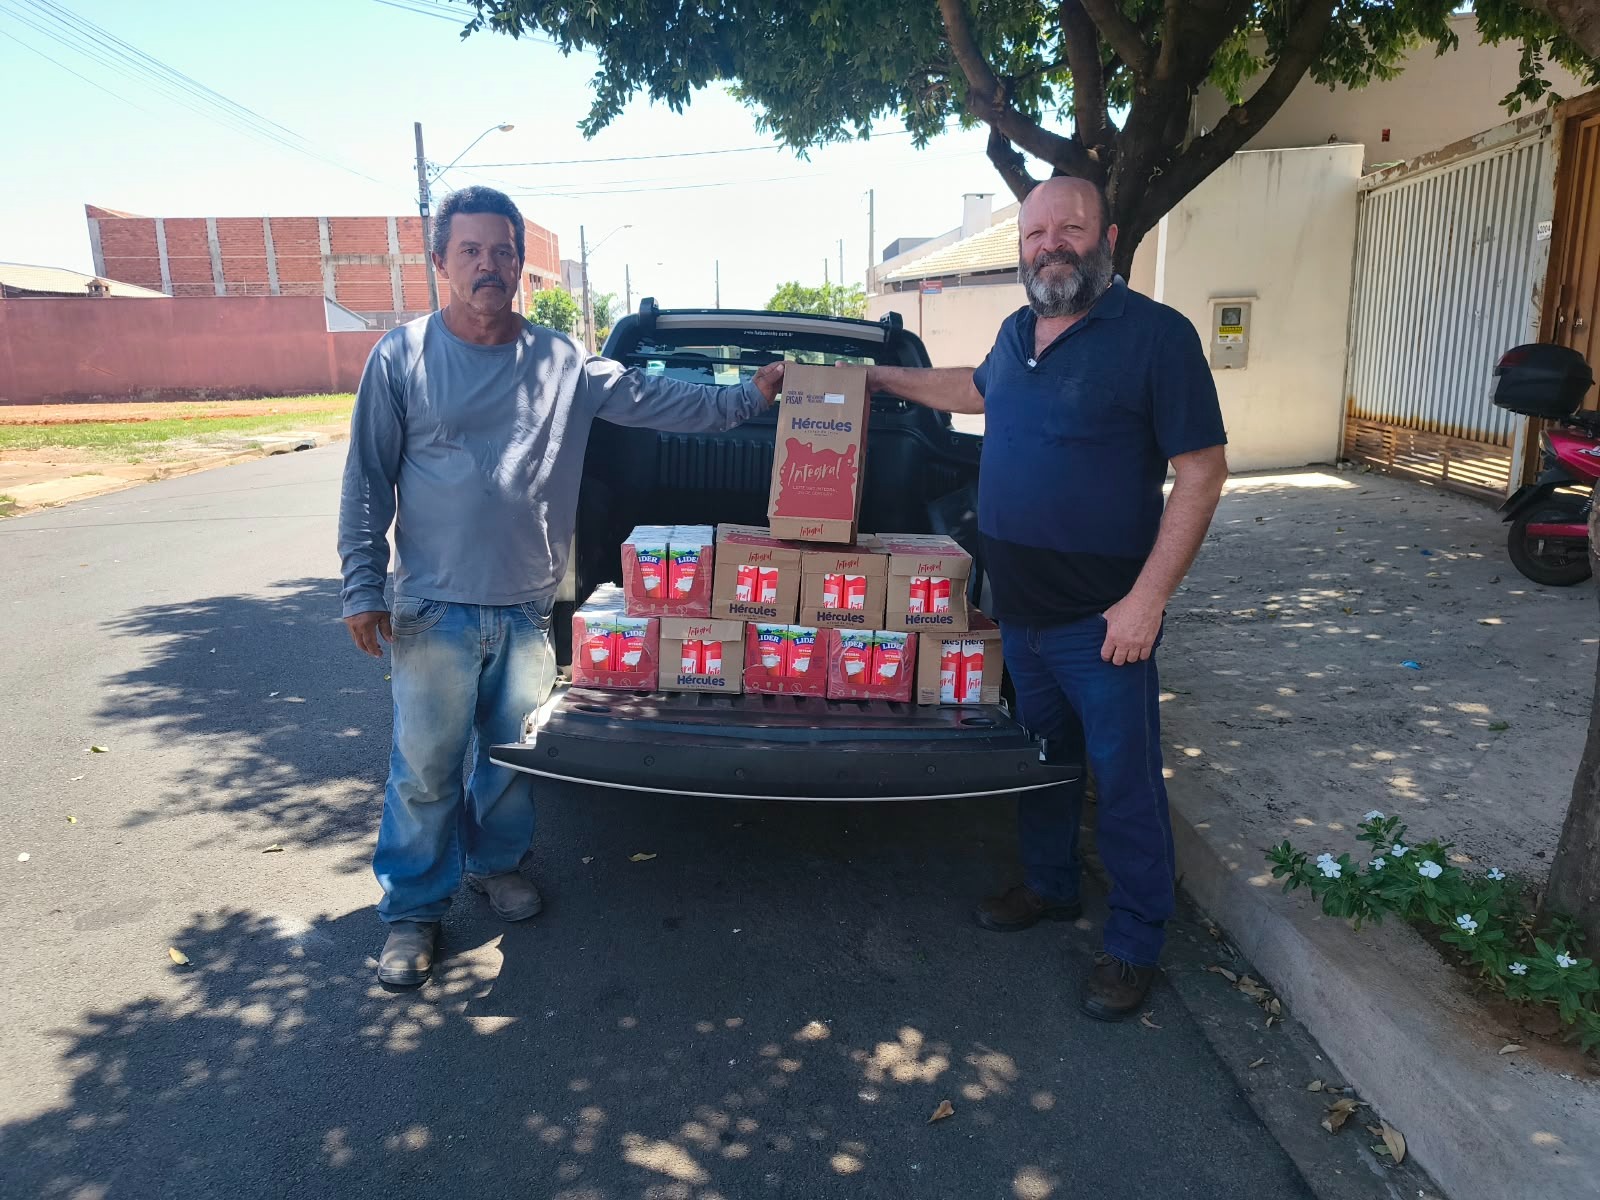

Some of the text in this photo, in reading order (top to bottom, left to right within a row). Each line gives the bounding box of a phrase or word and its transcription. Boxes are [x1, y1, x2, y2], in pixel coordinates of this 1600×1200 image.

[785, 395, 803, 404] PISAR
[791, 417, 853, 432] Hércules
[787, 456, 843, 487] Integral
[800, 523, 824, 537] Integral
[638, 555, 658, 564] IDER
[748, 550, 773, 563] Integral
[835, 557, 860, 570] Integral
[917, 561, 942, 574] Integral
[729, 603, 777, 617] Hércules
[816, 611, 865, 624] Hércules
[905, 614, 953, 625] Hércules
[687, 624, 713, 638] Integral
[758, 634, 780, 643] IDER
[795, 637, 815, 645] LIDE
[677, 674, 726, 687] Hércules
